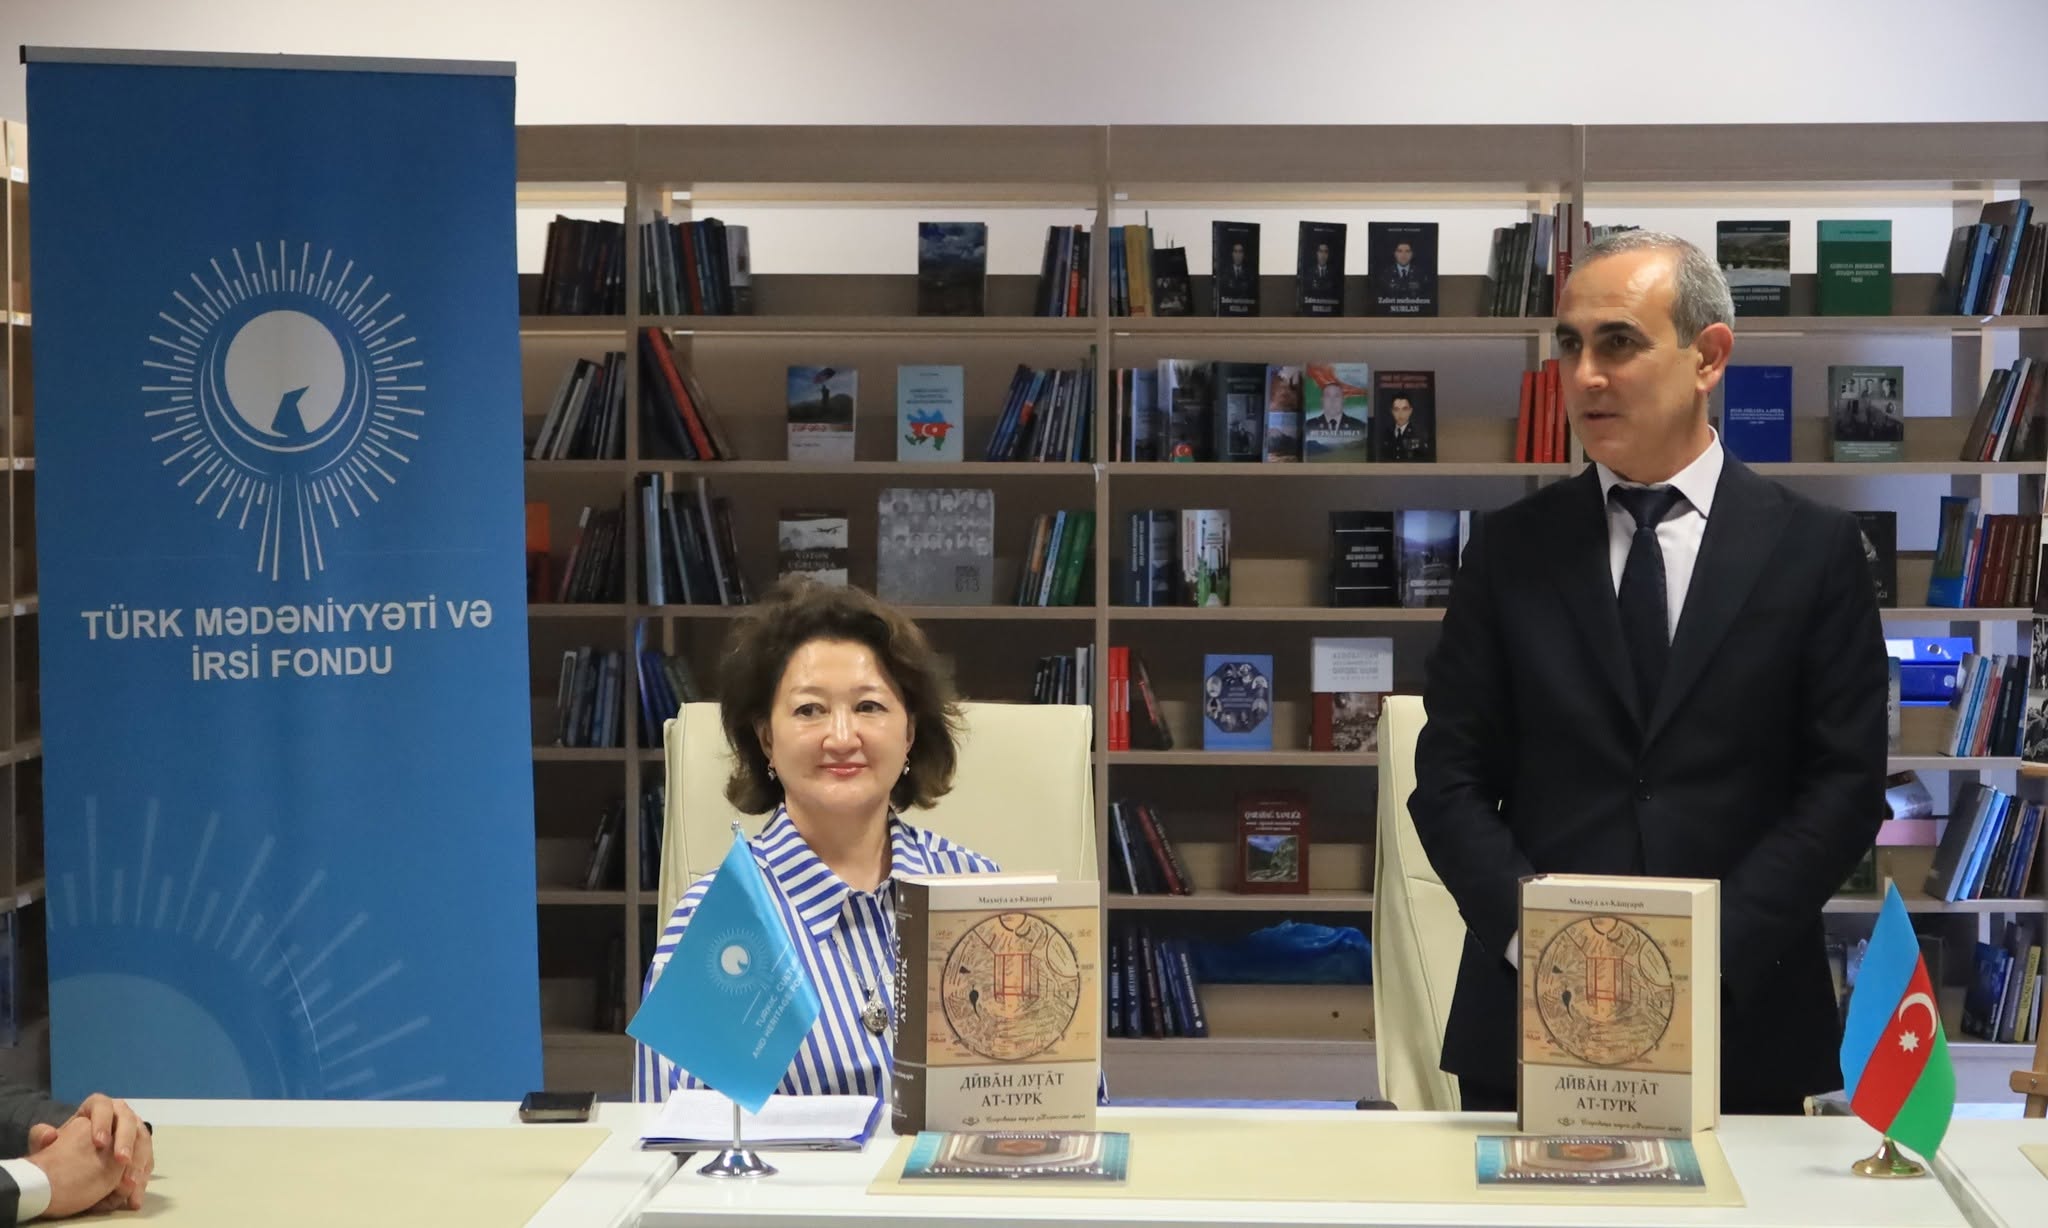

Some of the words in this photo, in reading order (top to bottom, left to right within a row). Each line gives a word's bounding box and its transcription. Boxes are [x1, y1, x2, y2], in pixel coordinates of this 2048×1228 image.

[81, 603, 183, 641] TÜRK
[195, 594, 437, 637] MƏDƏNİYYƏTİ
[446, 599, 494, 630] VƏ
[192, 643, 260, 681] İRSİ
[272, 645, 393, 678] FONDU
[982, 1092, 1043, 1108] АТ-ТУРК
[1576, 1097, 1638, 1113] АТ-ТУРК
